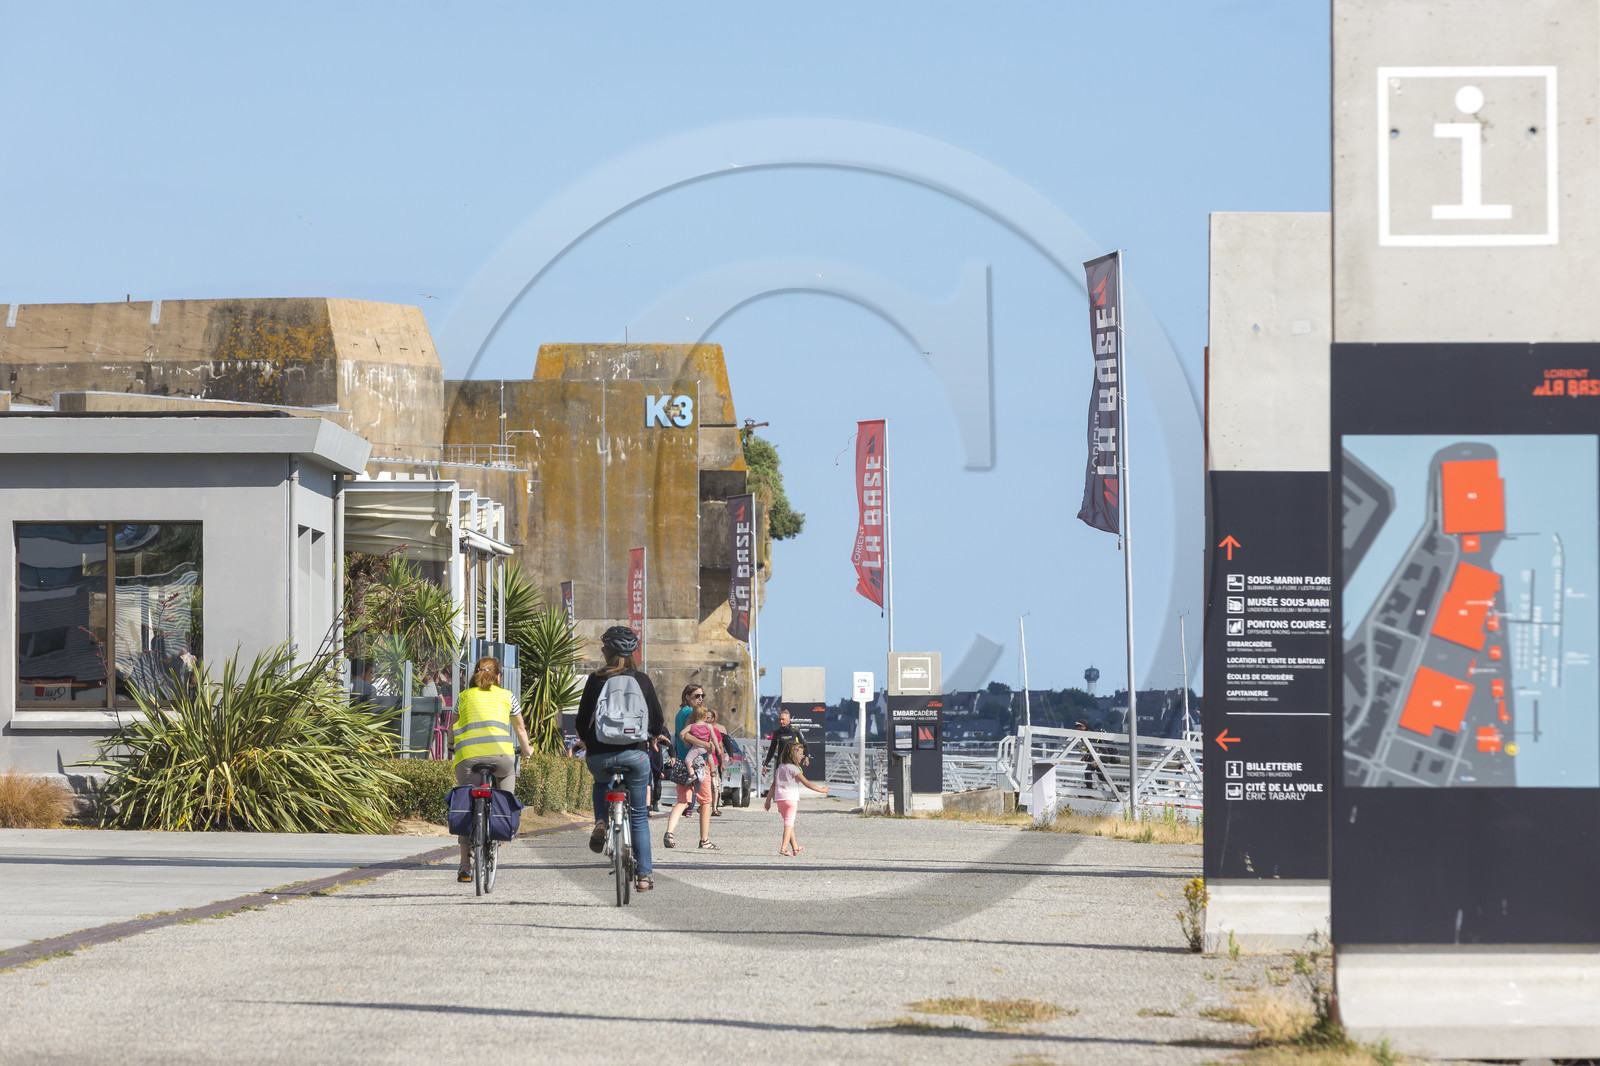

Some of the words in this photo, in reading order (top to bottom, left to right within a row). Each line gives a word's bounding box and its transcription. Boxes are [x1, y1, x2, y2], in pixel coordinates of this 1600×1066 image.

[1095, 306, 1118, 412] BASE
[1544, 368, 1588, 378] LORIENT
[1544, 379, 1564, 396] LA
[645, 394, 694, 428] K3
[1096, 427, 1118, 475] LA
[863, 455, 881, 526] BASE
[736, 522, 750, 578] BASE
[853, 525, 864, 566] LORIENT
[862, 535, 881, 568] LA
[1247, 576, 1303, 585] SOUS-MARIN
[736, 586, 750, 611] LA
[1247, 597, 1279, 607] MUSÉE
[1280, 598, 1331, 607] SOUS-MARI
[1247, 620, 1289, 629] PONTONS
[1290, 620, 1327, 629] COURSE
[1298, 657, 1325, 665] BATEAUX
[1261, 673, 1294, 681] CROISIÈRE
[893, 709, 938, 717] EMBARCADÈRE
[1246, 762, 1303, 771] BILLETTERIE
[1245, 781, 1267, 791] CITÉ
[1268, 783, 1281, 791] DE
[1283, 783, 1295, 792] LA
[1296, 784, 1323, 792] VOILE
